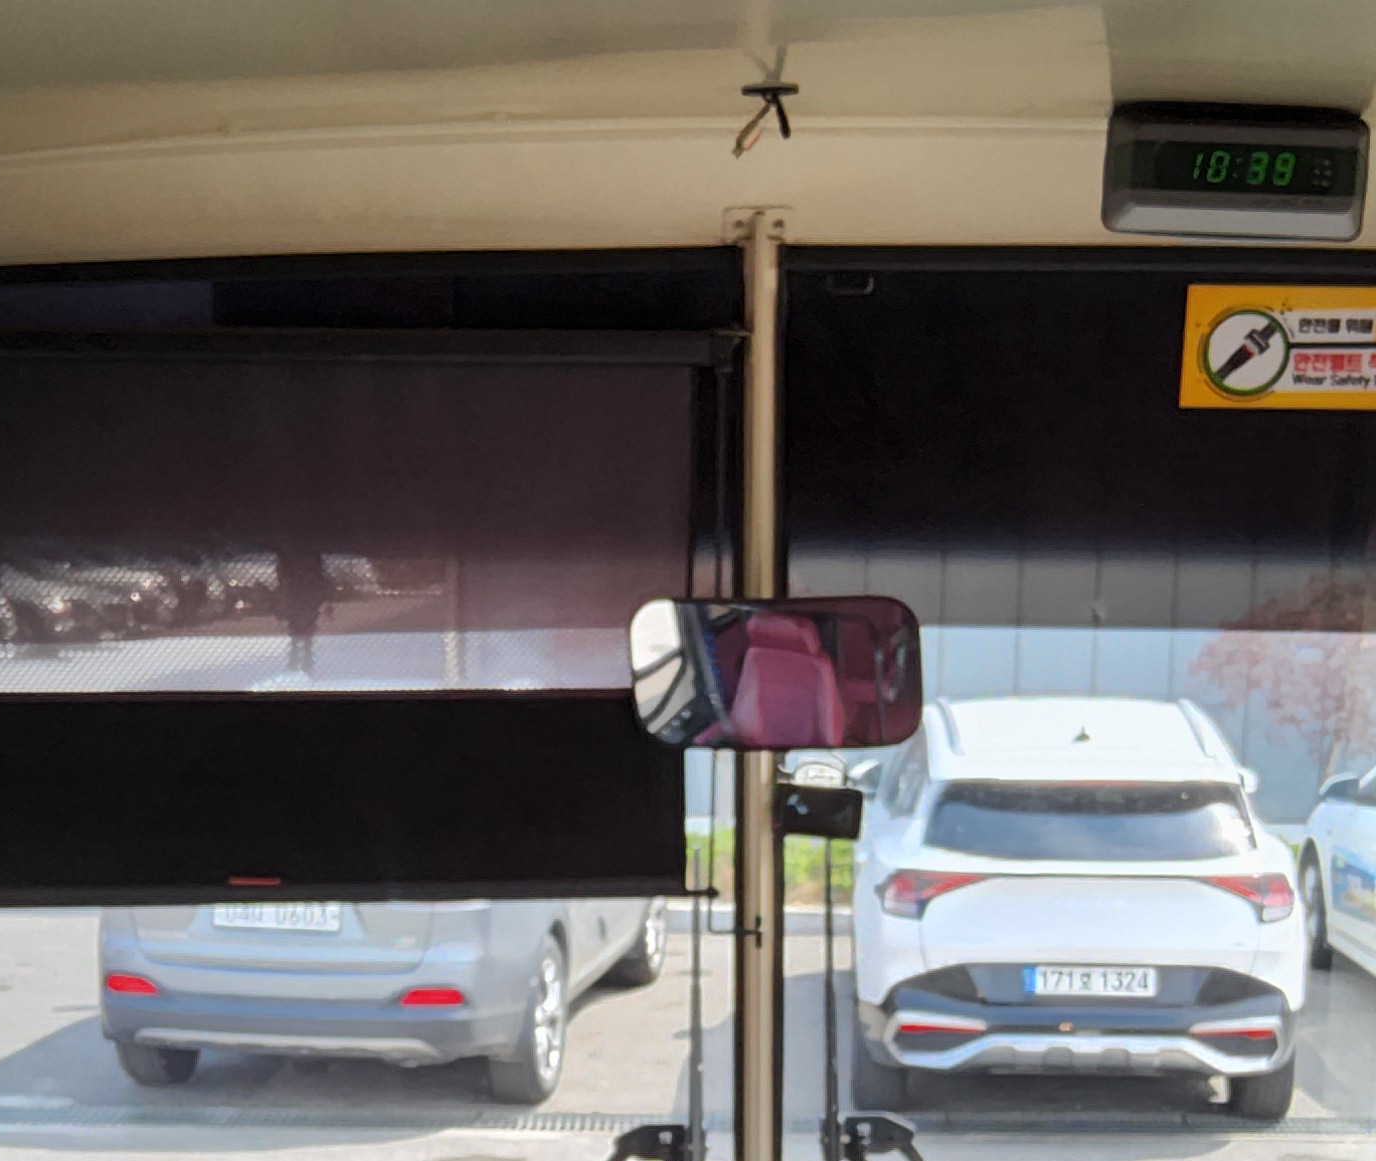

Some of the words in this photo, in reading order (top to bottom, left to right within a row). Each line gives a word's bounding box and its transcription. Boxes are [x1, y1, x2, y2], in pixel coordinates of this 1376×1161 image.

[1192, 151, 1296, 187] 10:39
[1292, 374, 1326, 385] Wear
[1330, 374, 1371, 390] Safety
[1100, 969, 1149, 992] 1324
